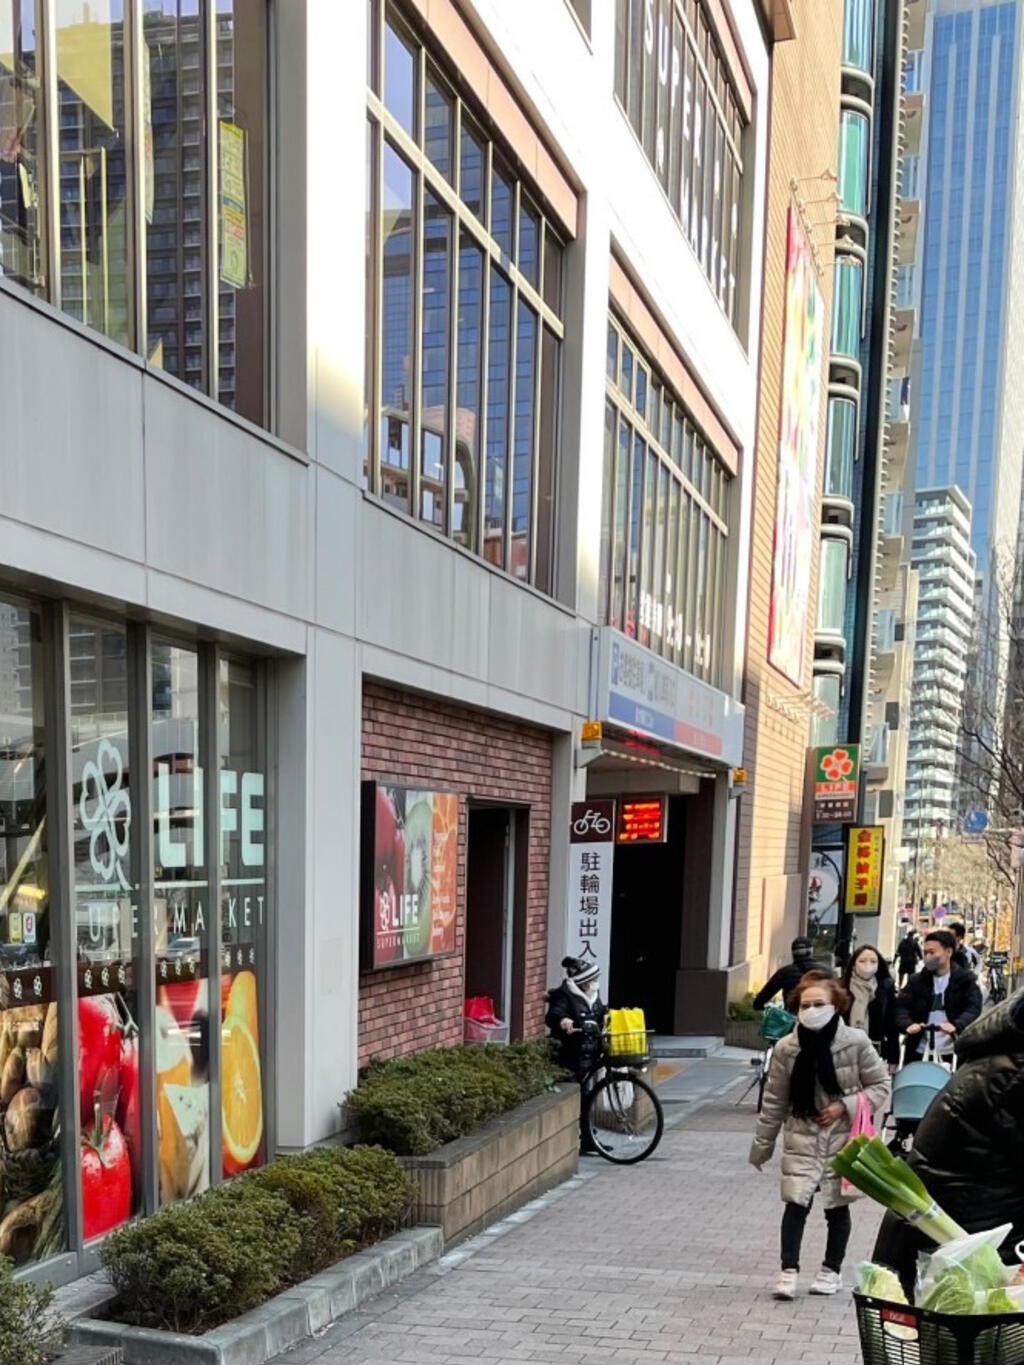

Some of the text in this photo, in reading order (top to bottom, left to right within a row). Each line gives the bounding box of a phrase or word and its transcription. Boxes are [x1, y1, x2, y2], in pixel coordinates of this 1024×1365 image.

[158, 763, 264, 867] LIFE
[392, 894, 419, 926] LIFE
[578, 852, 601, 959] 駐輪場出入
